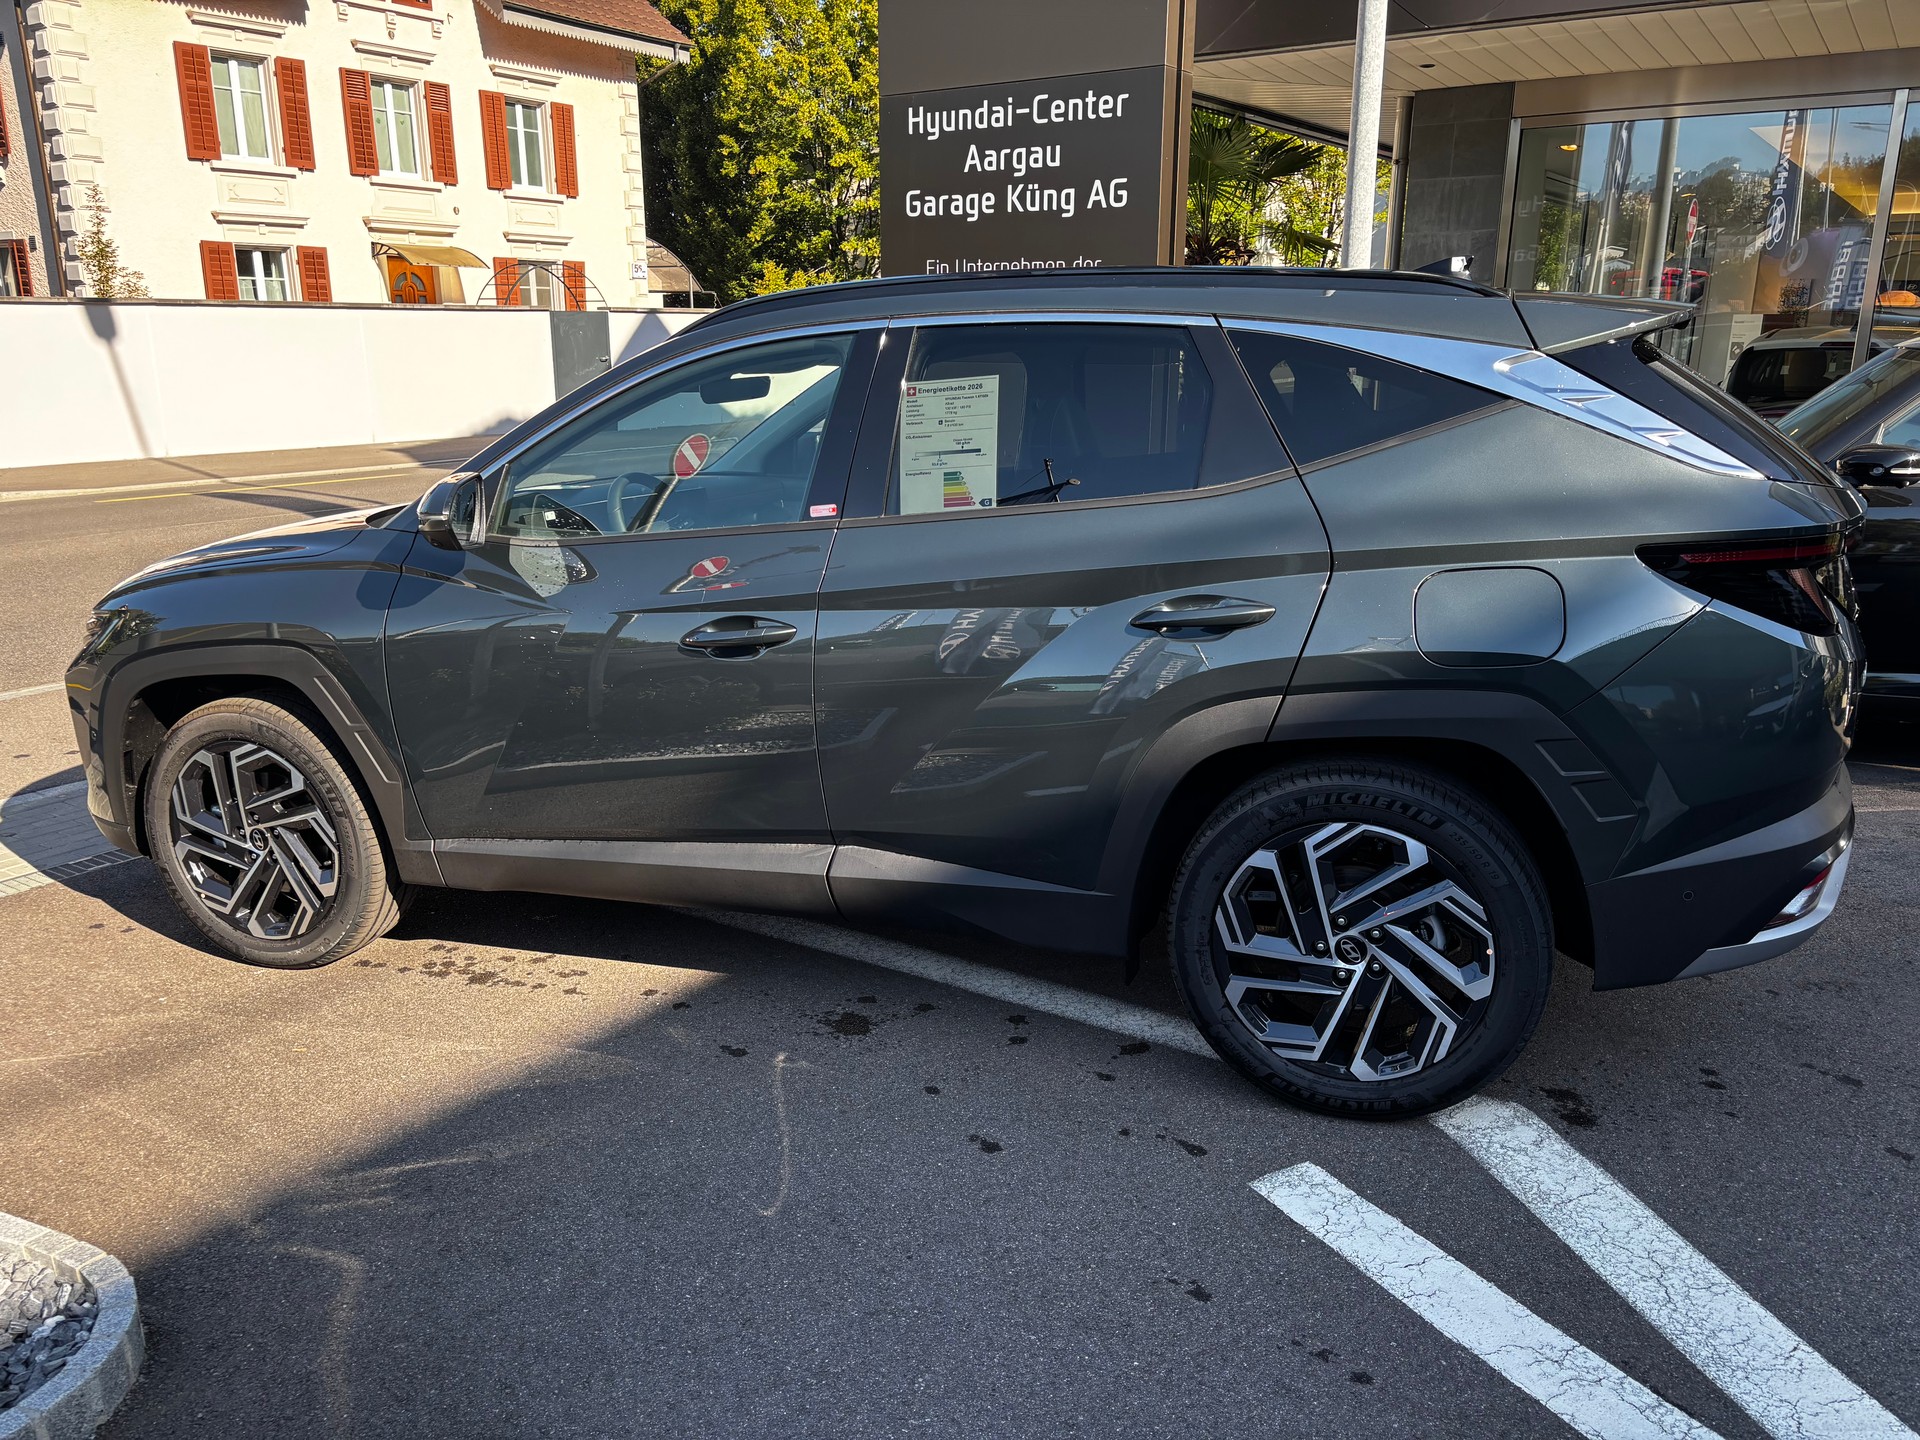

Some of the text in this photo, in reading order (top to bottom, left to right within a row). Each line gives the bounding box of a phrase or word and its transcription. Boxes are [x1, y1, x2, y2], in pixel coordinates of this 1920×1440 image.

[907, 90, 1130, 141] Hyundai-Center
[963, 144, 1061, 177] Aargau
[905, 177, 1128, 222] Garage Küng AG
[926, 259, 949, 275] Ein
[918, 385, 966, 394] Energieetikette
[1306, 792, 1438, 826] MICHELIN
[1448, 831, 1500, 881] 235/50 R 19
